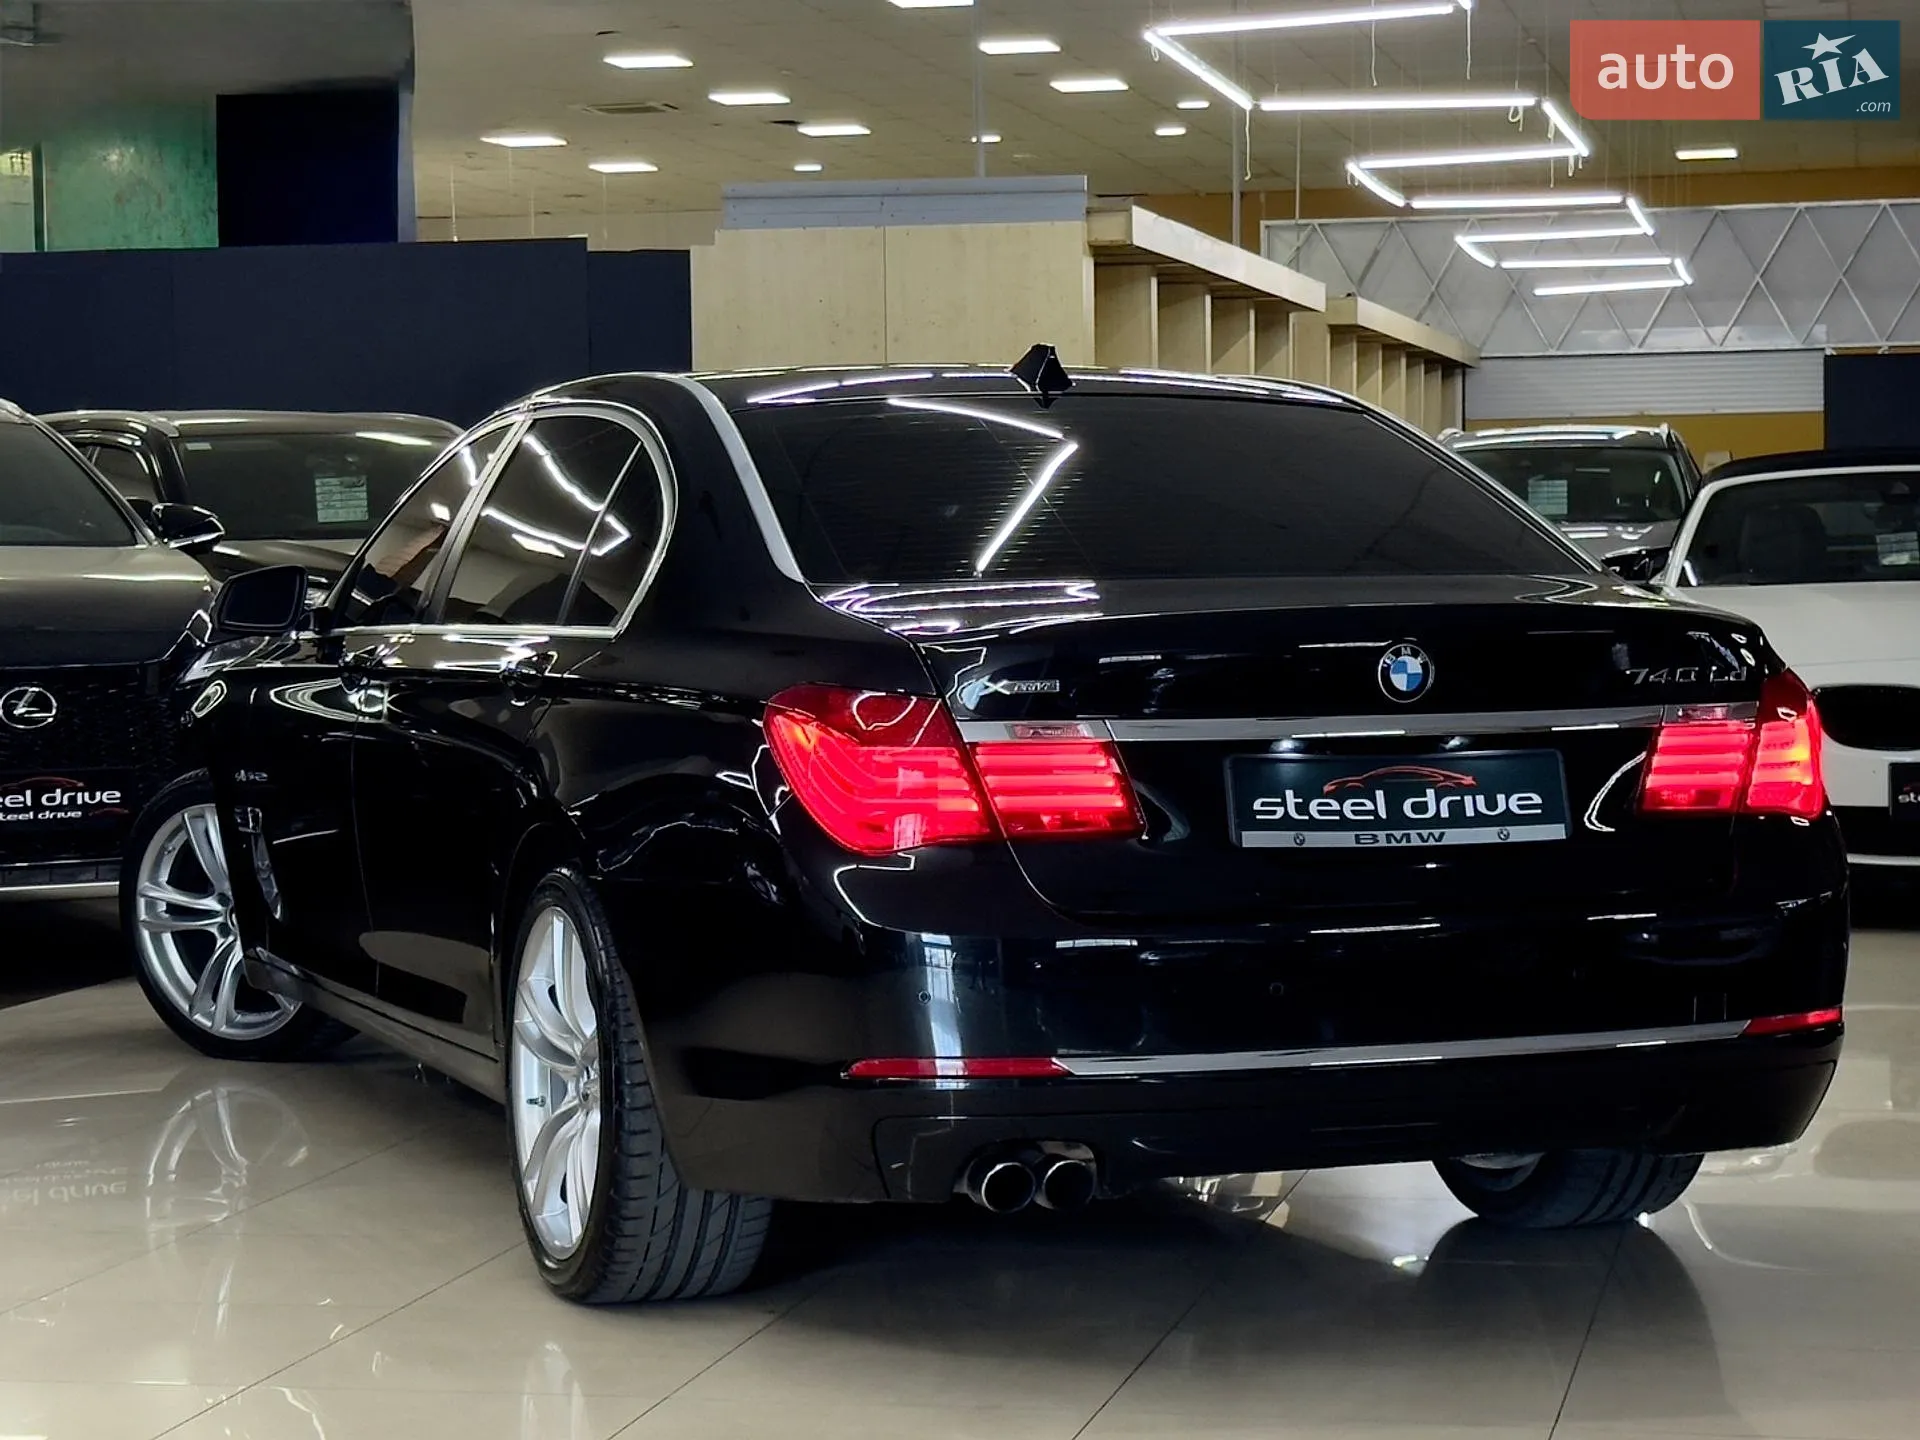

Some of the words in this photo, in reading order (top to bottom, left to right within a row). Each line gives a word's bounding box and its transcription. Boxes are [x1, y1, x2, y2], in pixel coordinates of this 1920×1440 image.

[41, 788, 121, 806] drive
[1253, 789, 1388, 821] steel
[1402, 788, 1543, 819] drive
[38, 810, 82, 820] drive
[1354, 831, 1446, 845] BMW
